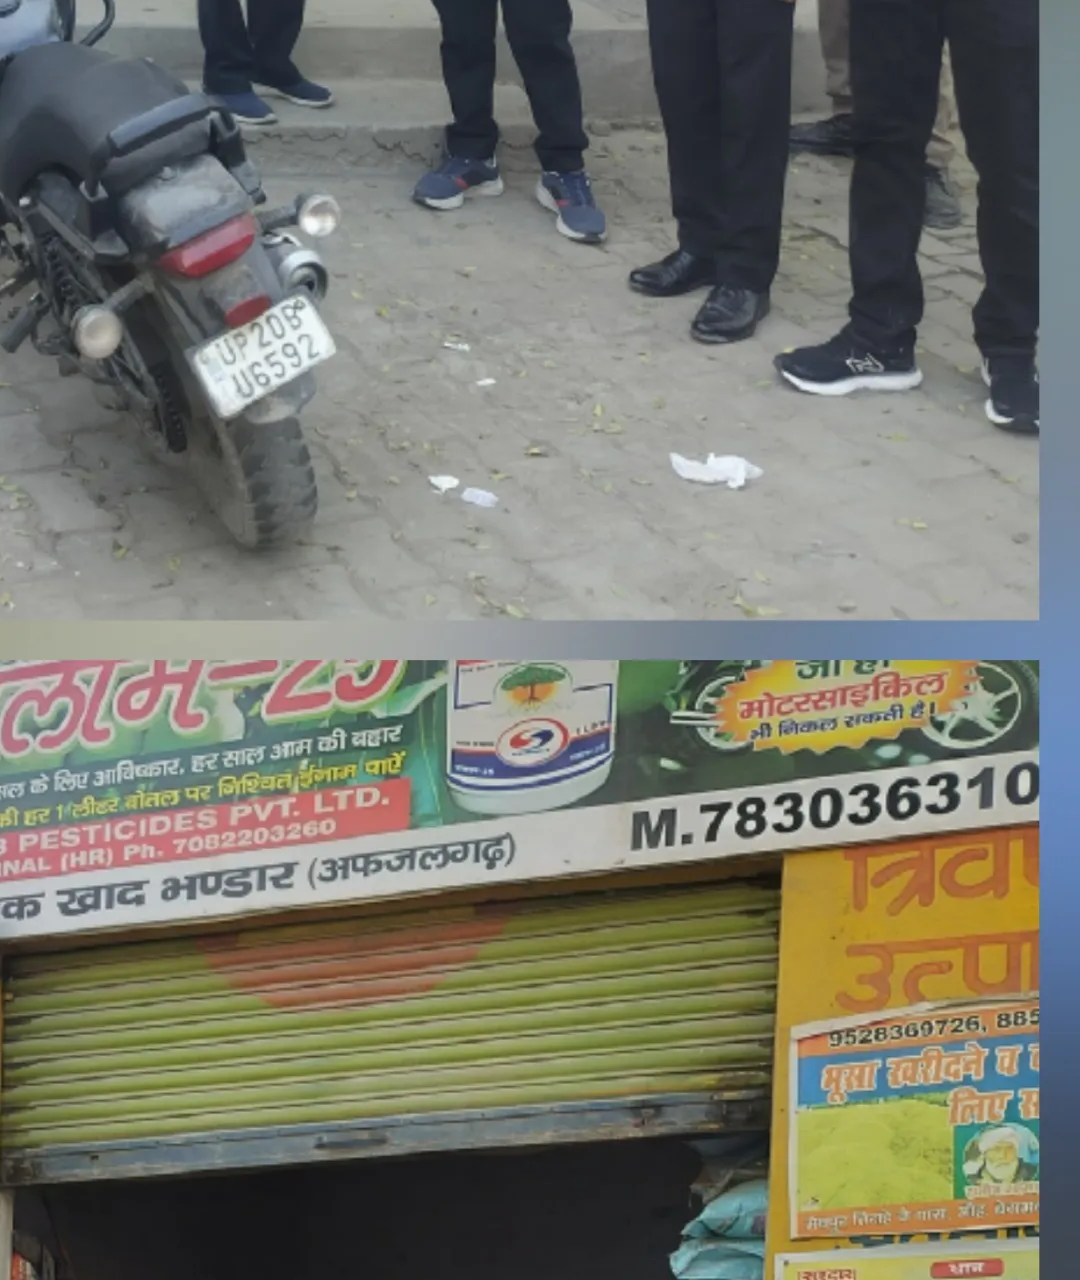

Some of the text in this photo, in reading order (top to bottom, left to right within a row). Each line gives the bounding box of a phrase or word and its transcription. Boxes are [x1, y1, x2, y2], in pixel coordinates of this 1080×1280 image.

[232, 333, 320, 399] U6592
[739, 671, 949, 719] मोटरसाइकिल
[750, 722, 773, 740] भी
[779, 717, 839, 737] निकल
[845, 703, 905, 728] सकती
[30, 773, 49, 794] के
[54, 769, 90, 792] लिए
[191, 752, 219, 773] हर
[222, 744, 266, 768] साल
[269, 738, 314, 761] आम
[316, 728, 348, 752] की
[20, 809, 218, 854] PESTICIDES
[230, 797, 300, 826] PVT.
[314, 787, 390, 814] LTD.
[61, 848, 113, 872] (HR)
[123, 843, 164, 861] Ph.
[173, 819, 336, 854] 7082203260
[57, 831, 515, 915] खाद भण्डार (अफजलगढ़)
[821, 1044, 1022, 1104] भूसा खरीदने व
[949, 1089, 1013, 1126] लिए
